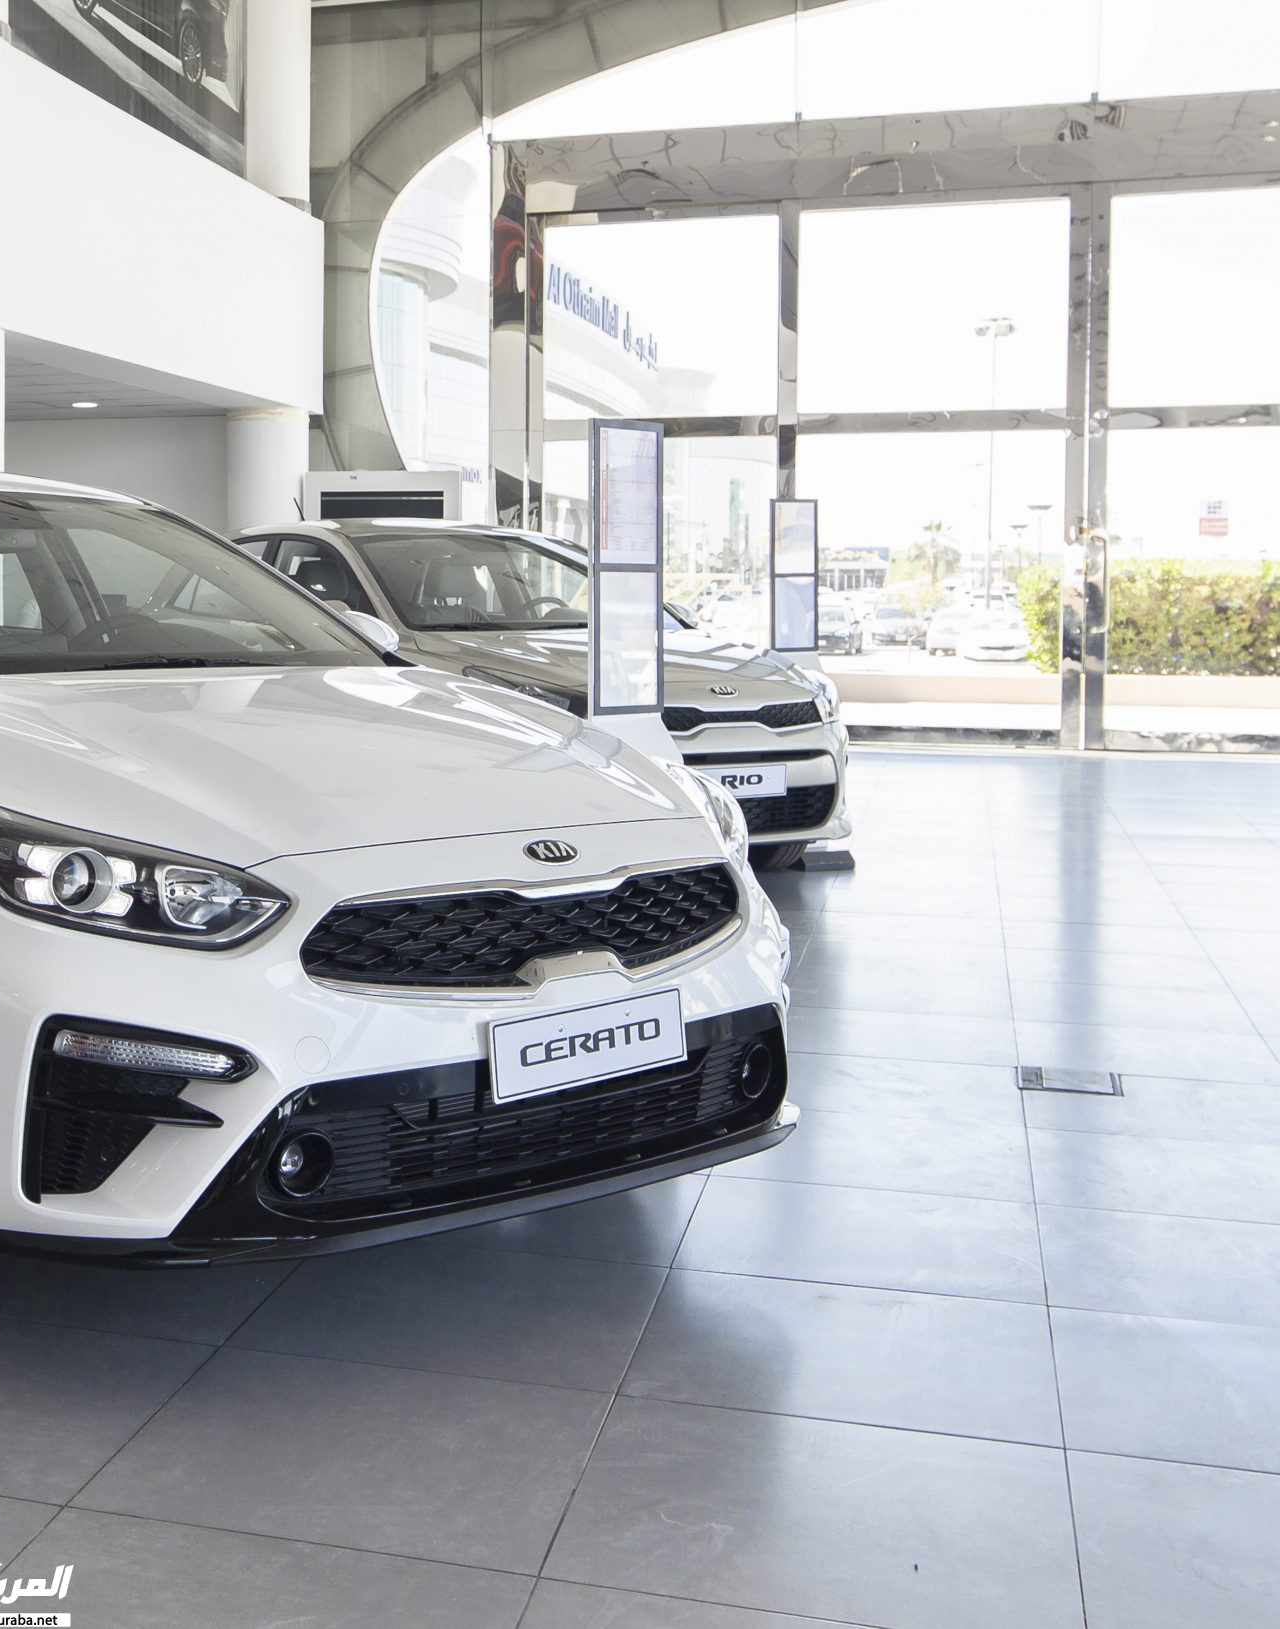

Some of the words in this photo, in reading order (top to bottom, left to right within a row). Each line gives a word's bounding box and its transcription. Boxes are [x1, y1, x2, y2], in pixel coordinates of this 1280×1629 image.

[547, 263, 561, 305] Al
[563, 272, 600, 328] Othaim
[602, 296, 619, 339] Mall
[712, 685, 736, 694] KIA
[720, 773, 763, 790] RIO
[531, 841, 576, 860] KIA
[519, 1017, 661, 1067] CERATO
